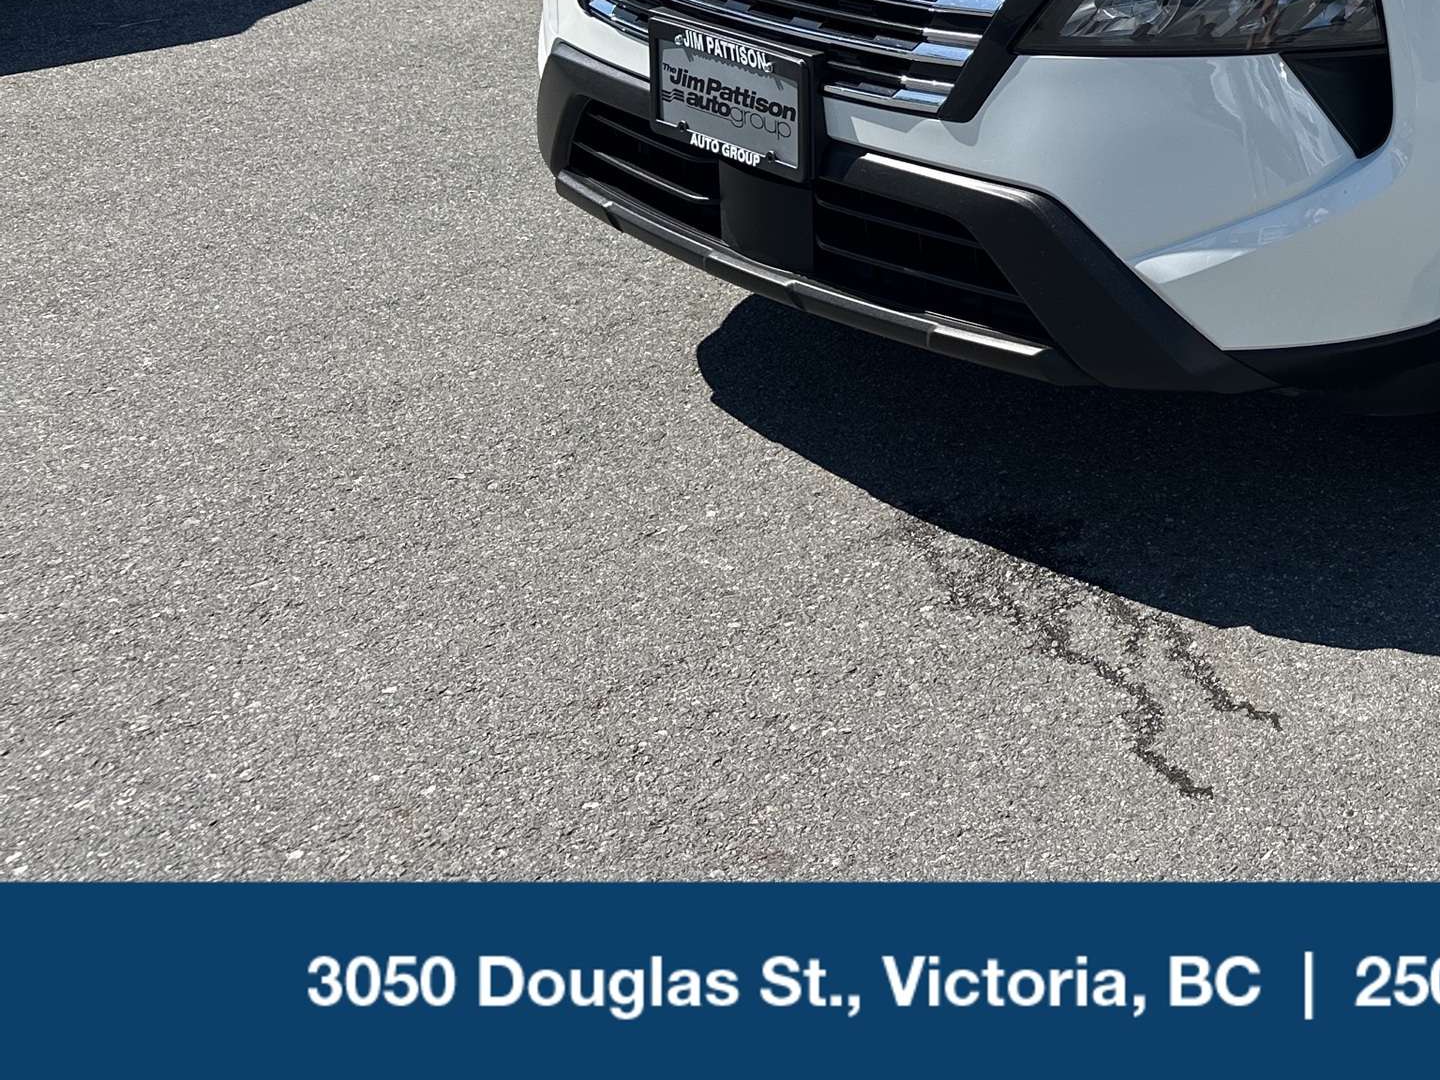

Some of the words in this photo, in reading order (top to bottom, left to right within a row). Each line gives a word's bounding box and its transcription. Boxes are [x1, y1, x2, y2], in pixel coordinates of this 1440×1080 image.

[683, 29, 704, 52] JIM
[706, 37, 767, 70] PATTISON
[662, 62, 677, 73] The
[690, 133, 719, 153] AUTO
[721, 143, 760, 166] GROUP
